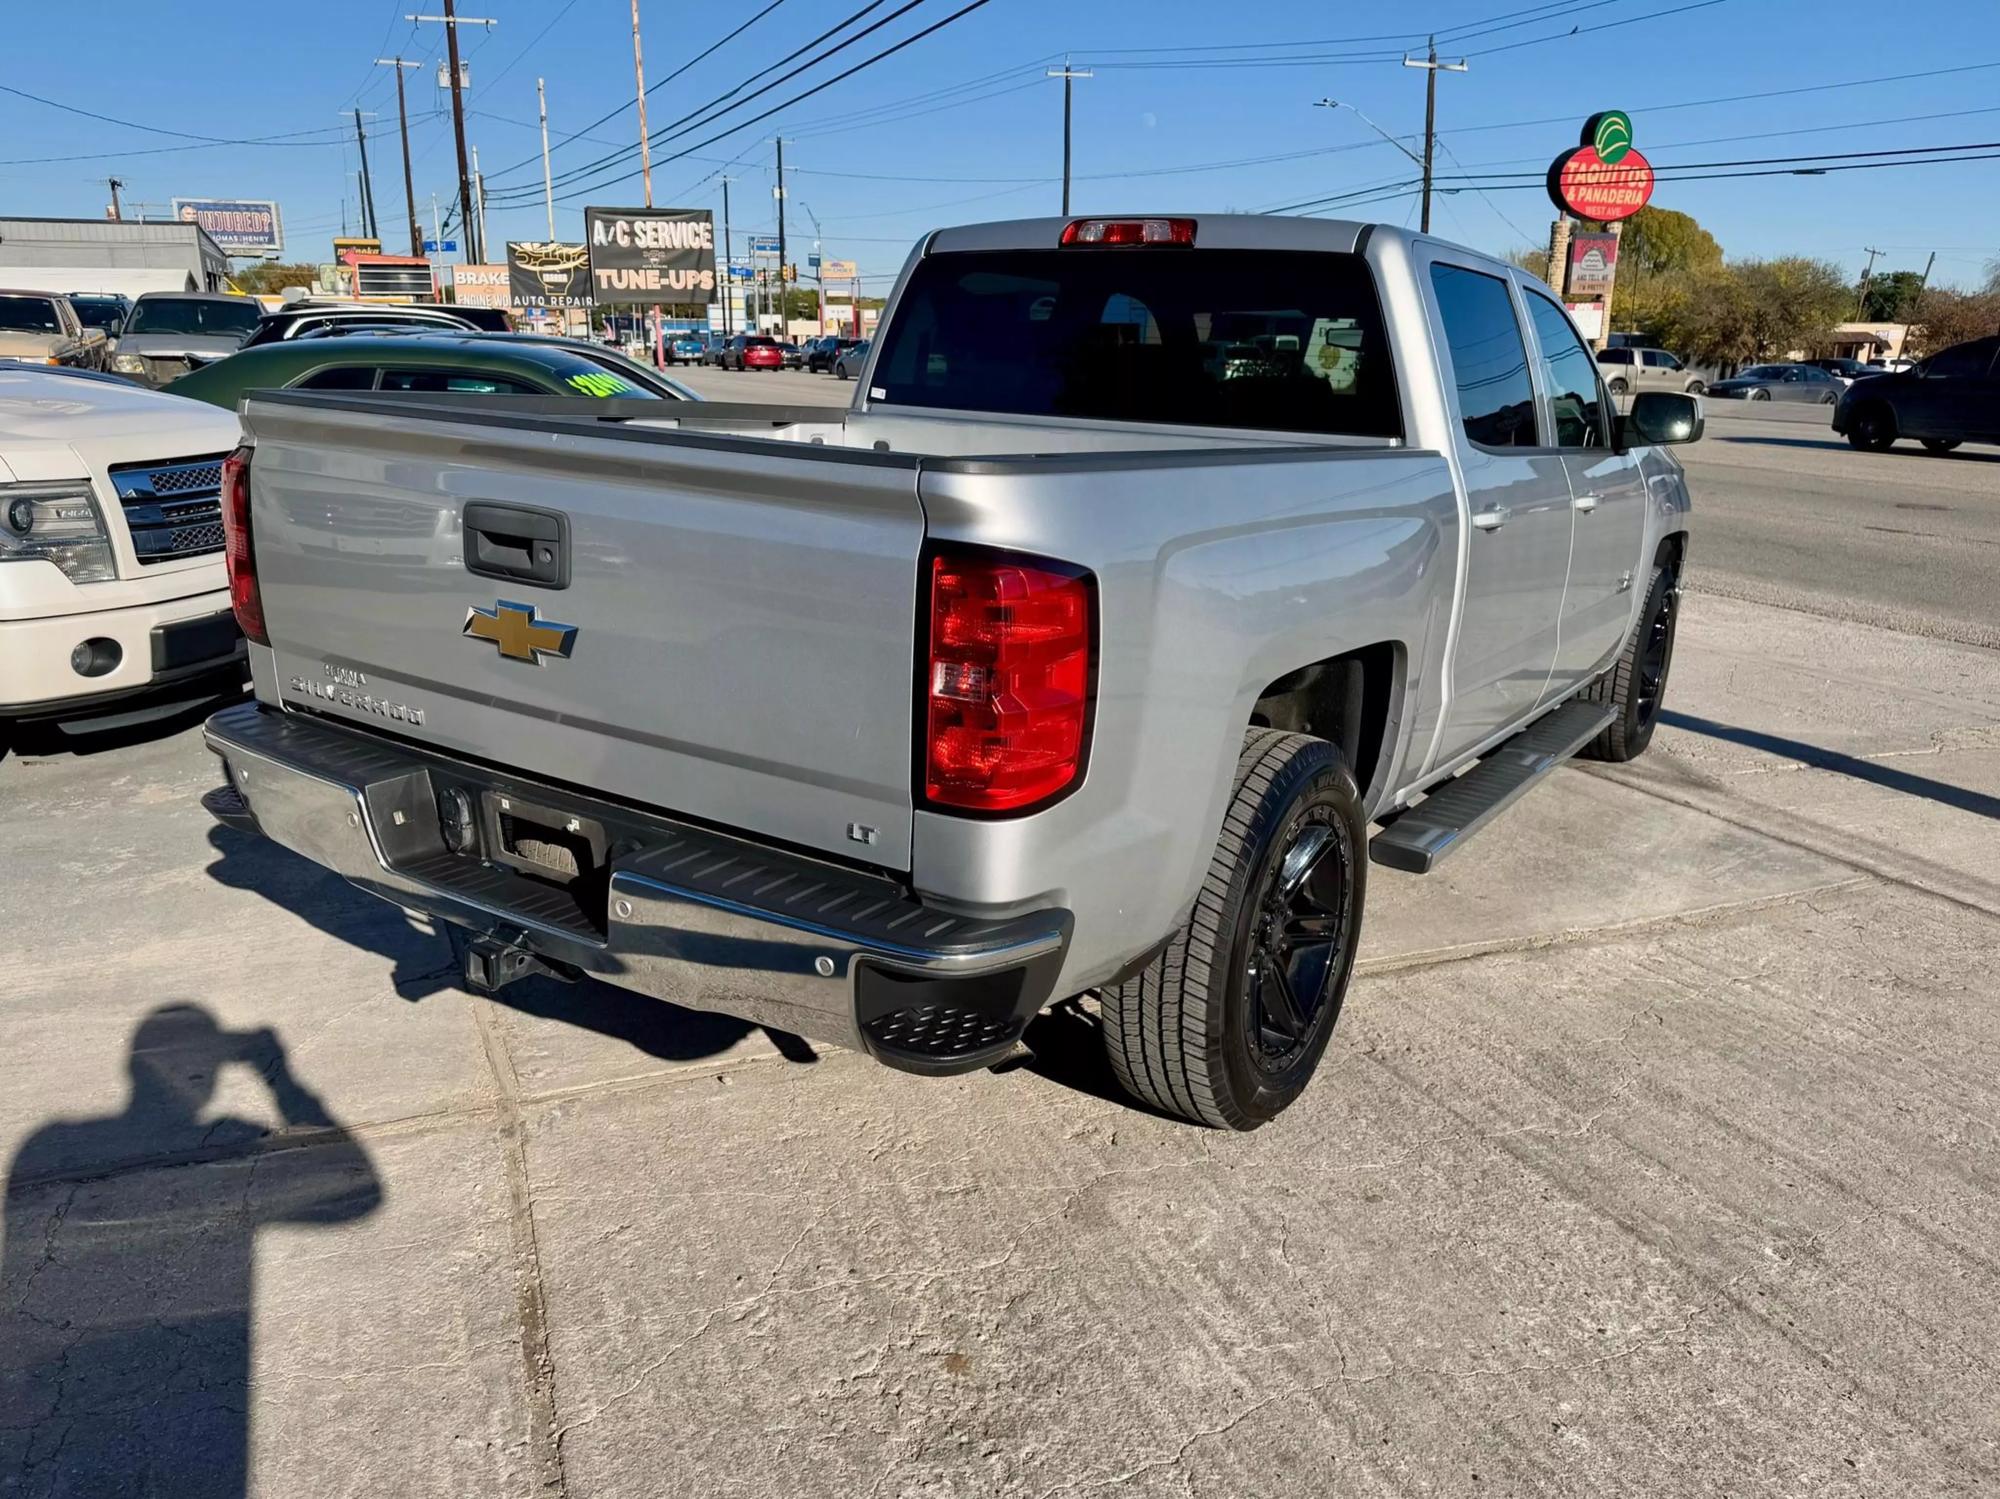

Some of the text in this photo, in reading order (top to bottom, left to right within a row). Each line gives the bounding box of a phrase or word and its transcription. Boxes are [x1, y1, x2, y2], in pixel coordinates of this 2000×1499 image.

[1567, 161, 1650, 188] TAQUITOS
[1567, 186, 1644, 206] & PANADERIA
[198, 210, 271, 232] INJURED?
[1585, 205, 1606, 216] WEST
[211, 234, 238, 242] OMAS
[593, 219, 713, 249] A/C SERVICE
[595, 268, 714, 290] TUNE-UPS
[457, 294, 511, 307] ENGINE WO
[514, 296, 600, 307] AUTO REPAIR
[289, 677, 425, 727] SILVERADO
[846, 823, 880, 846] LT
